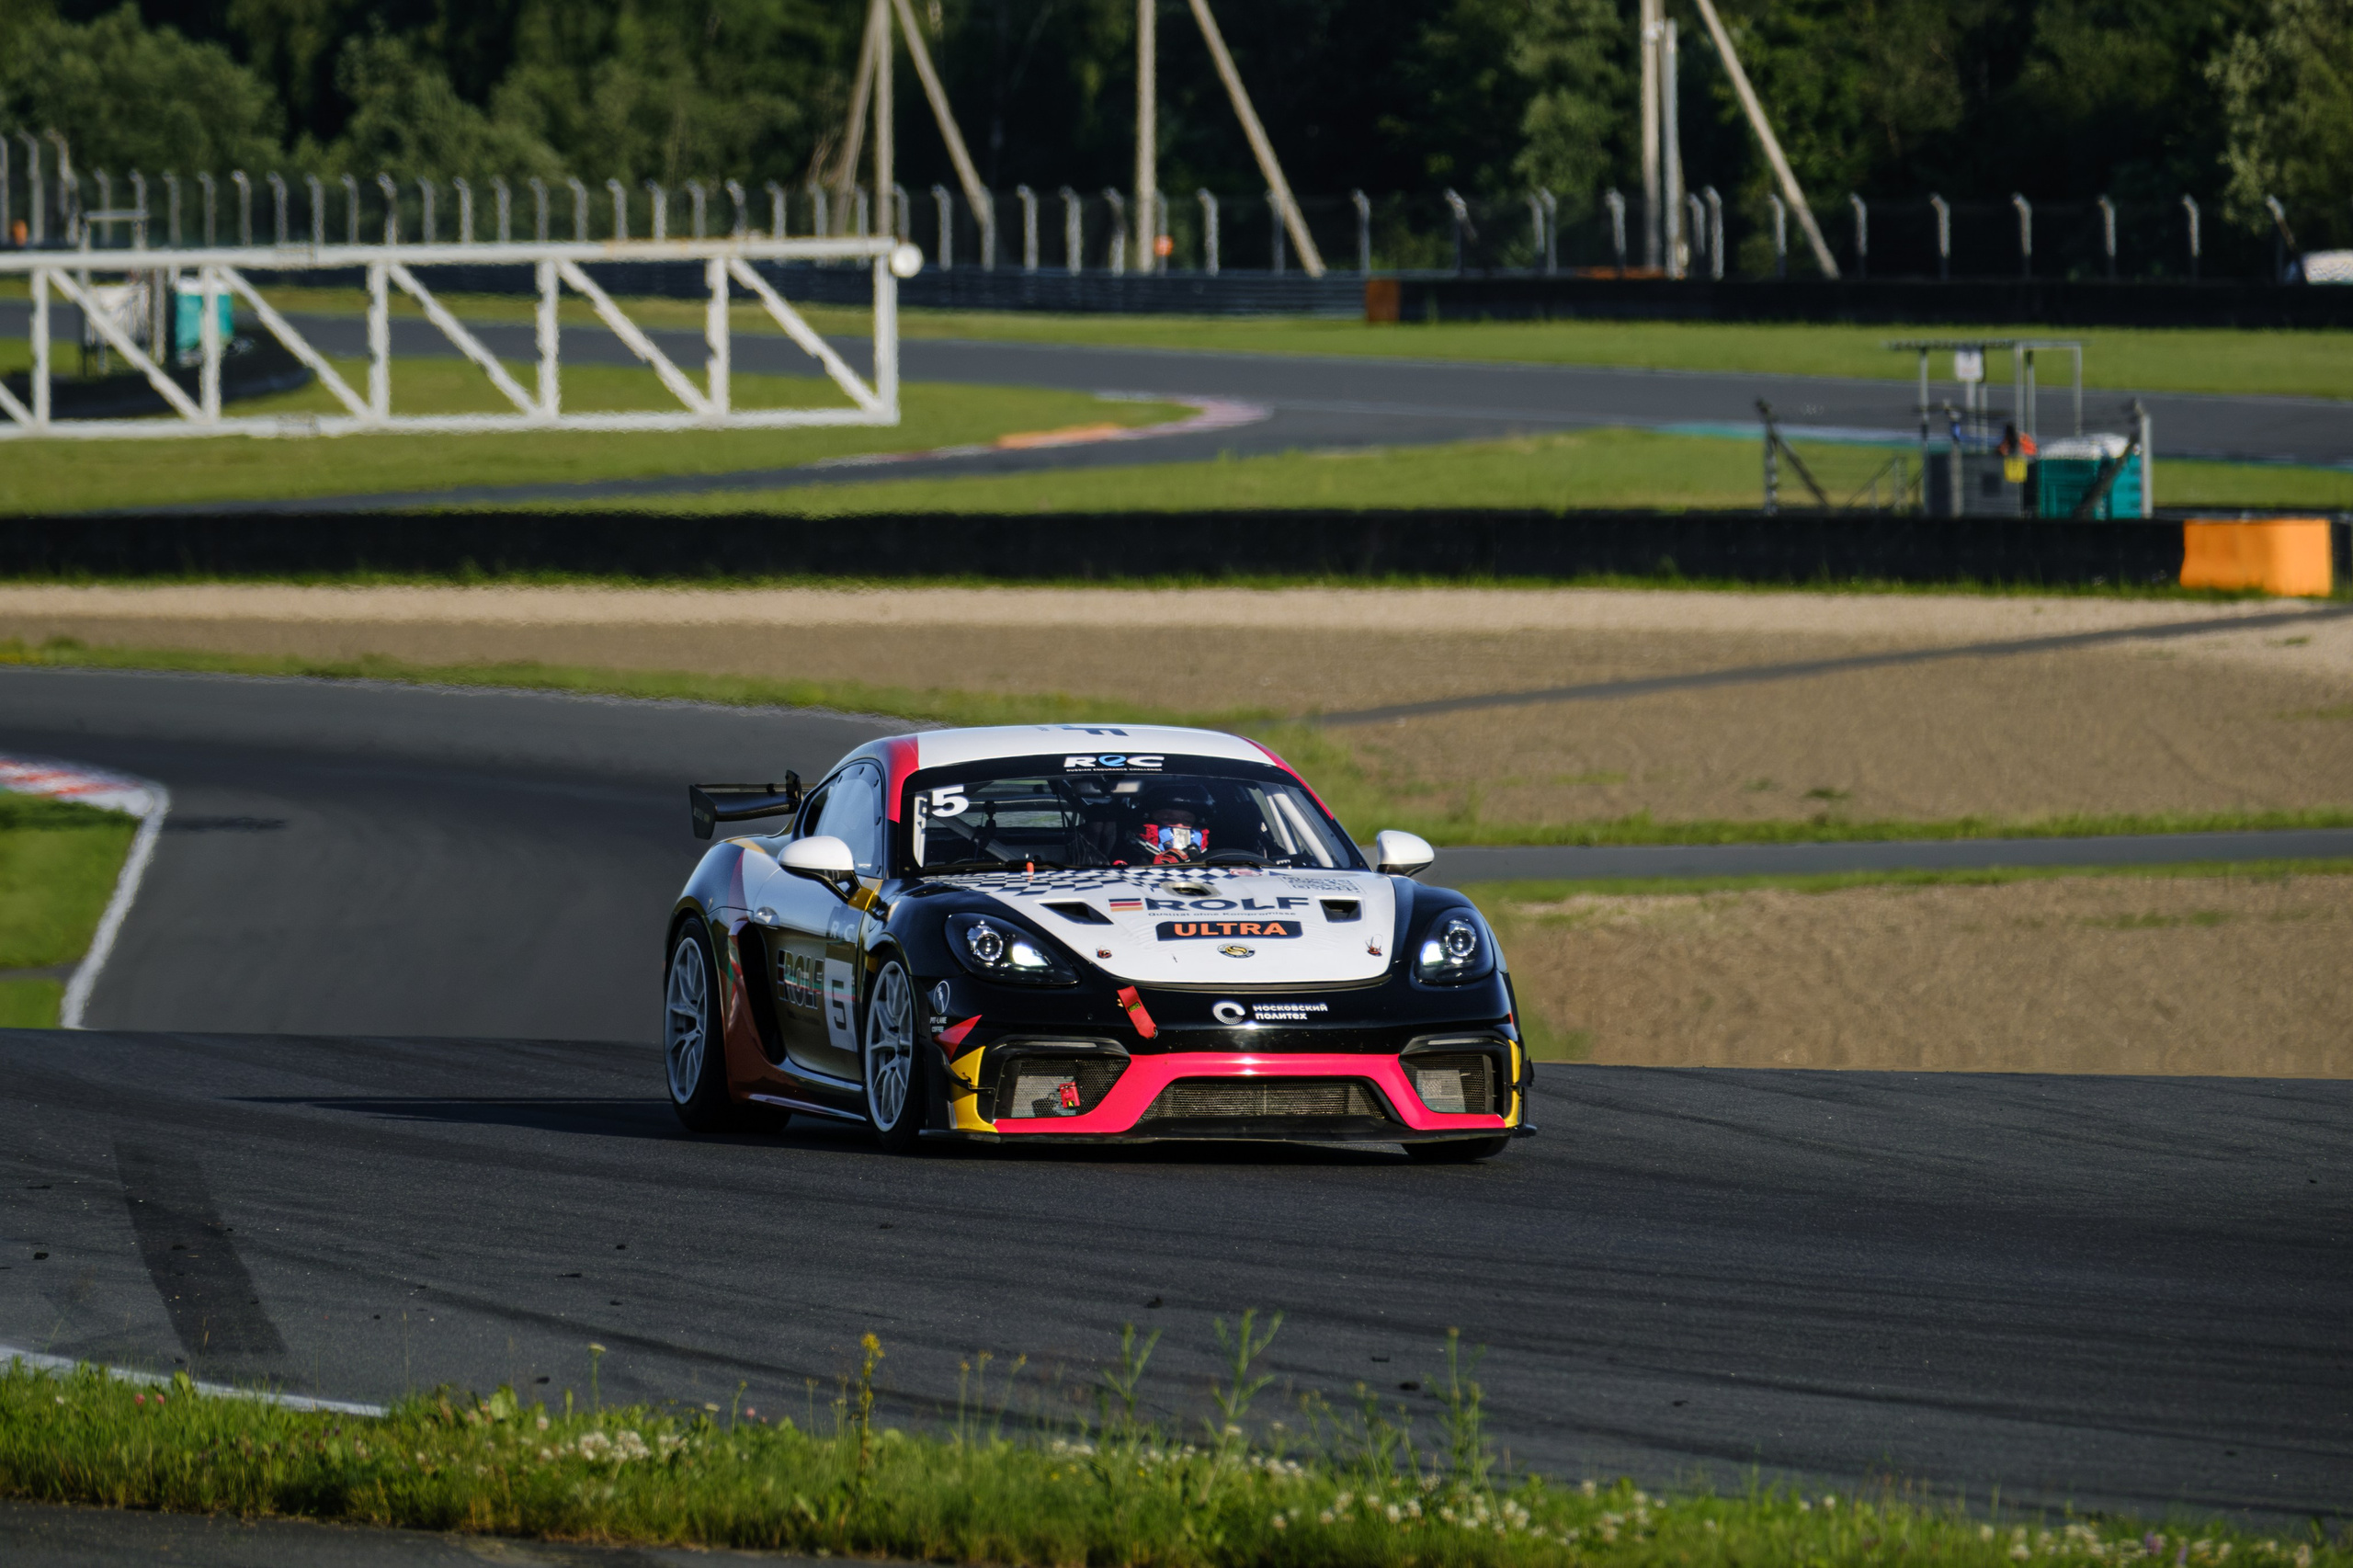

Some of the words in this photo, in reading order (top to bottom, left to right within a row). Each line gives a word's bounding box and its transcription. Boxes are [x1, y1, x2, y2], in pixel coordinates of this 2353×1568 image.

[931, 785, 969, 817] 5
[1145, 896, 1309, 911] ROLF
[1174, 922, 1288, 937] ULTRA
[832, 979, 847, 1030] 5
